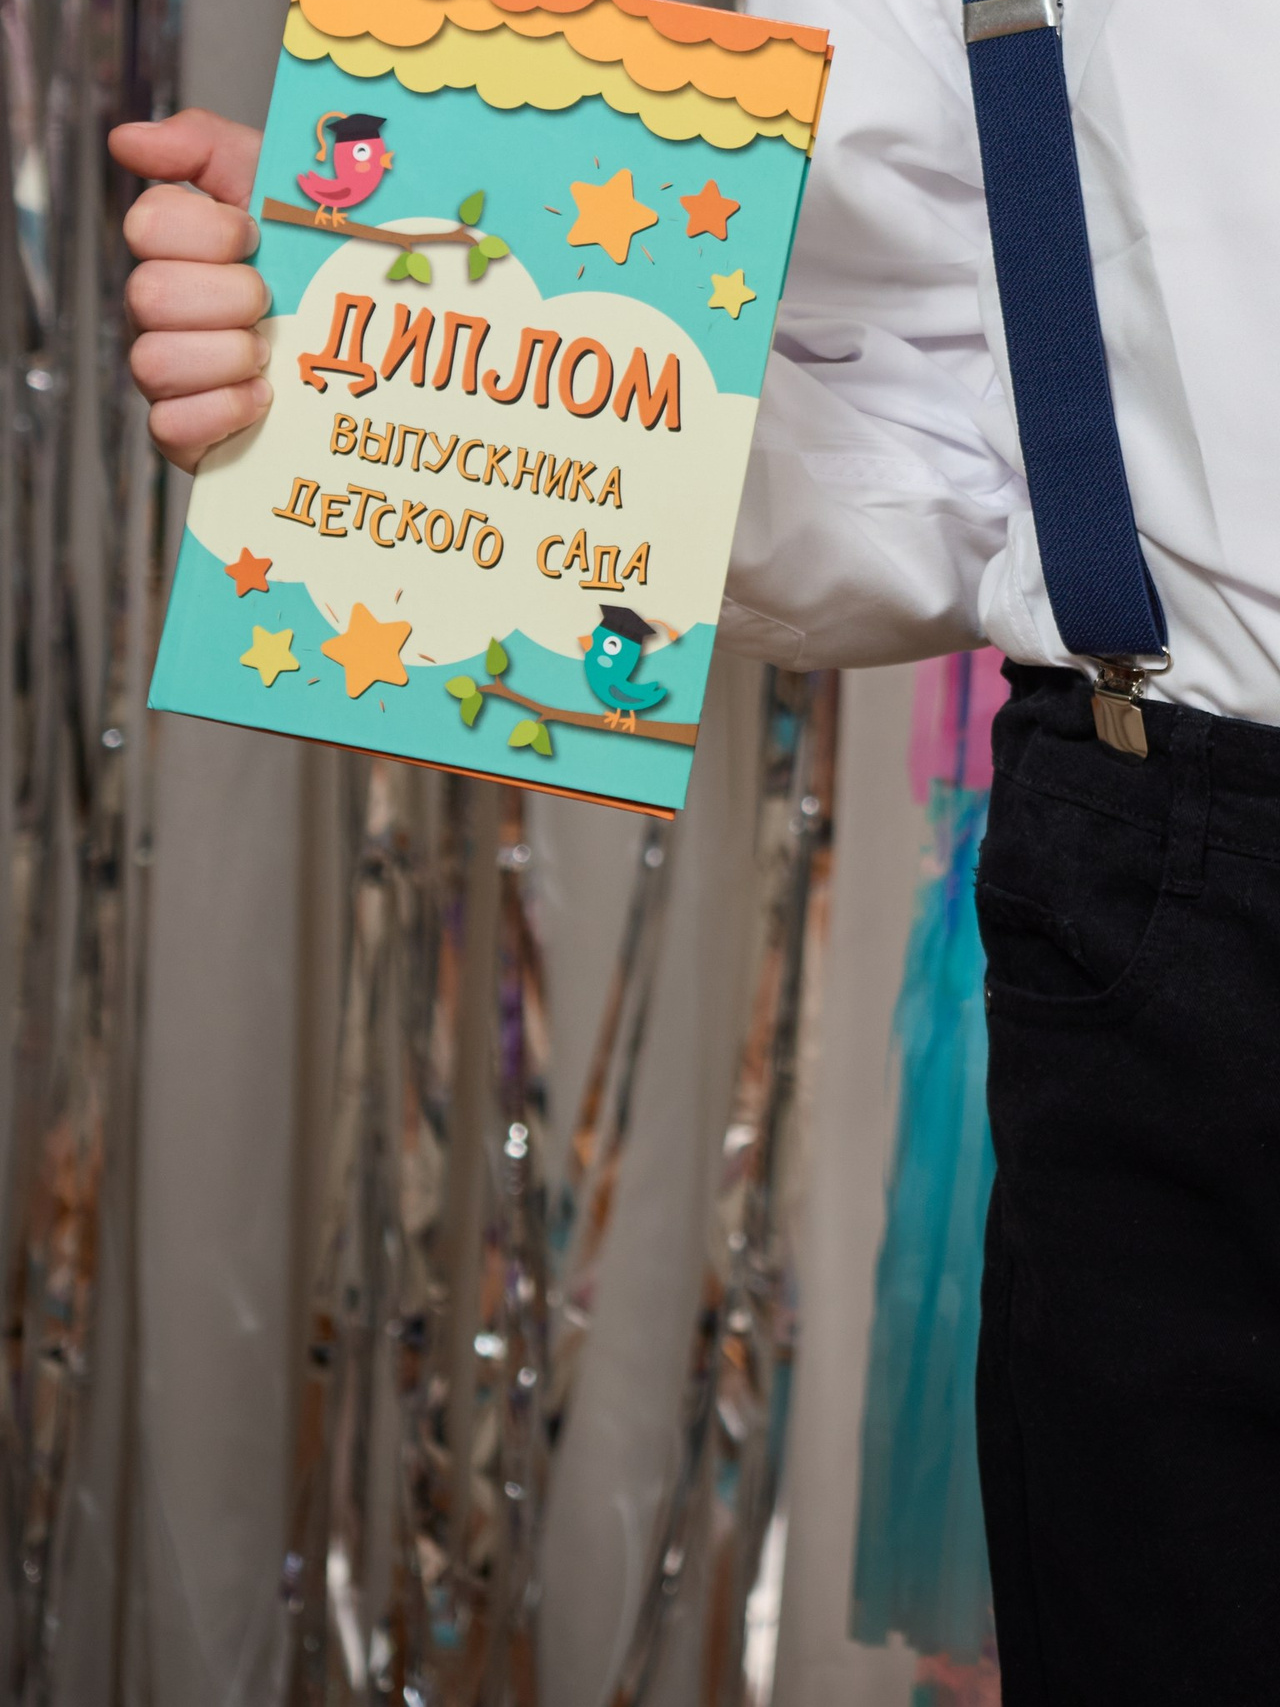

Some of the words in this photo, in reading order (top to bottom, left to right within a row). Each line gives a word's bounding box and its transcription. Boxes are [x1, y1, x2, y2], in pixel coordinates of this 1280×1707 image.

[297, 291, 682, 432] ДИПЛОМ
[329, 412, 624, 510] ВЫПУСКНИКА
[271, 476, 504, 570] ДЕТСКОГО
[536, 528, 652, 592] САДА
